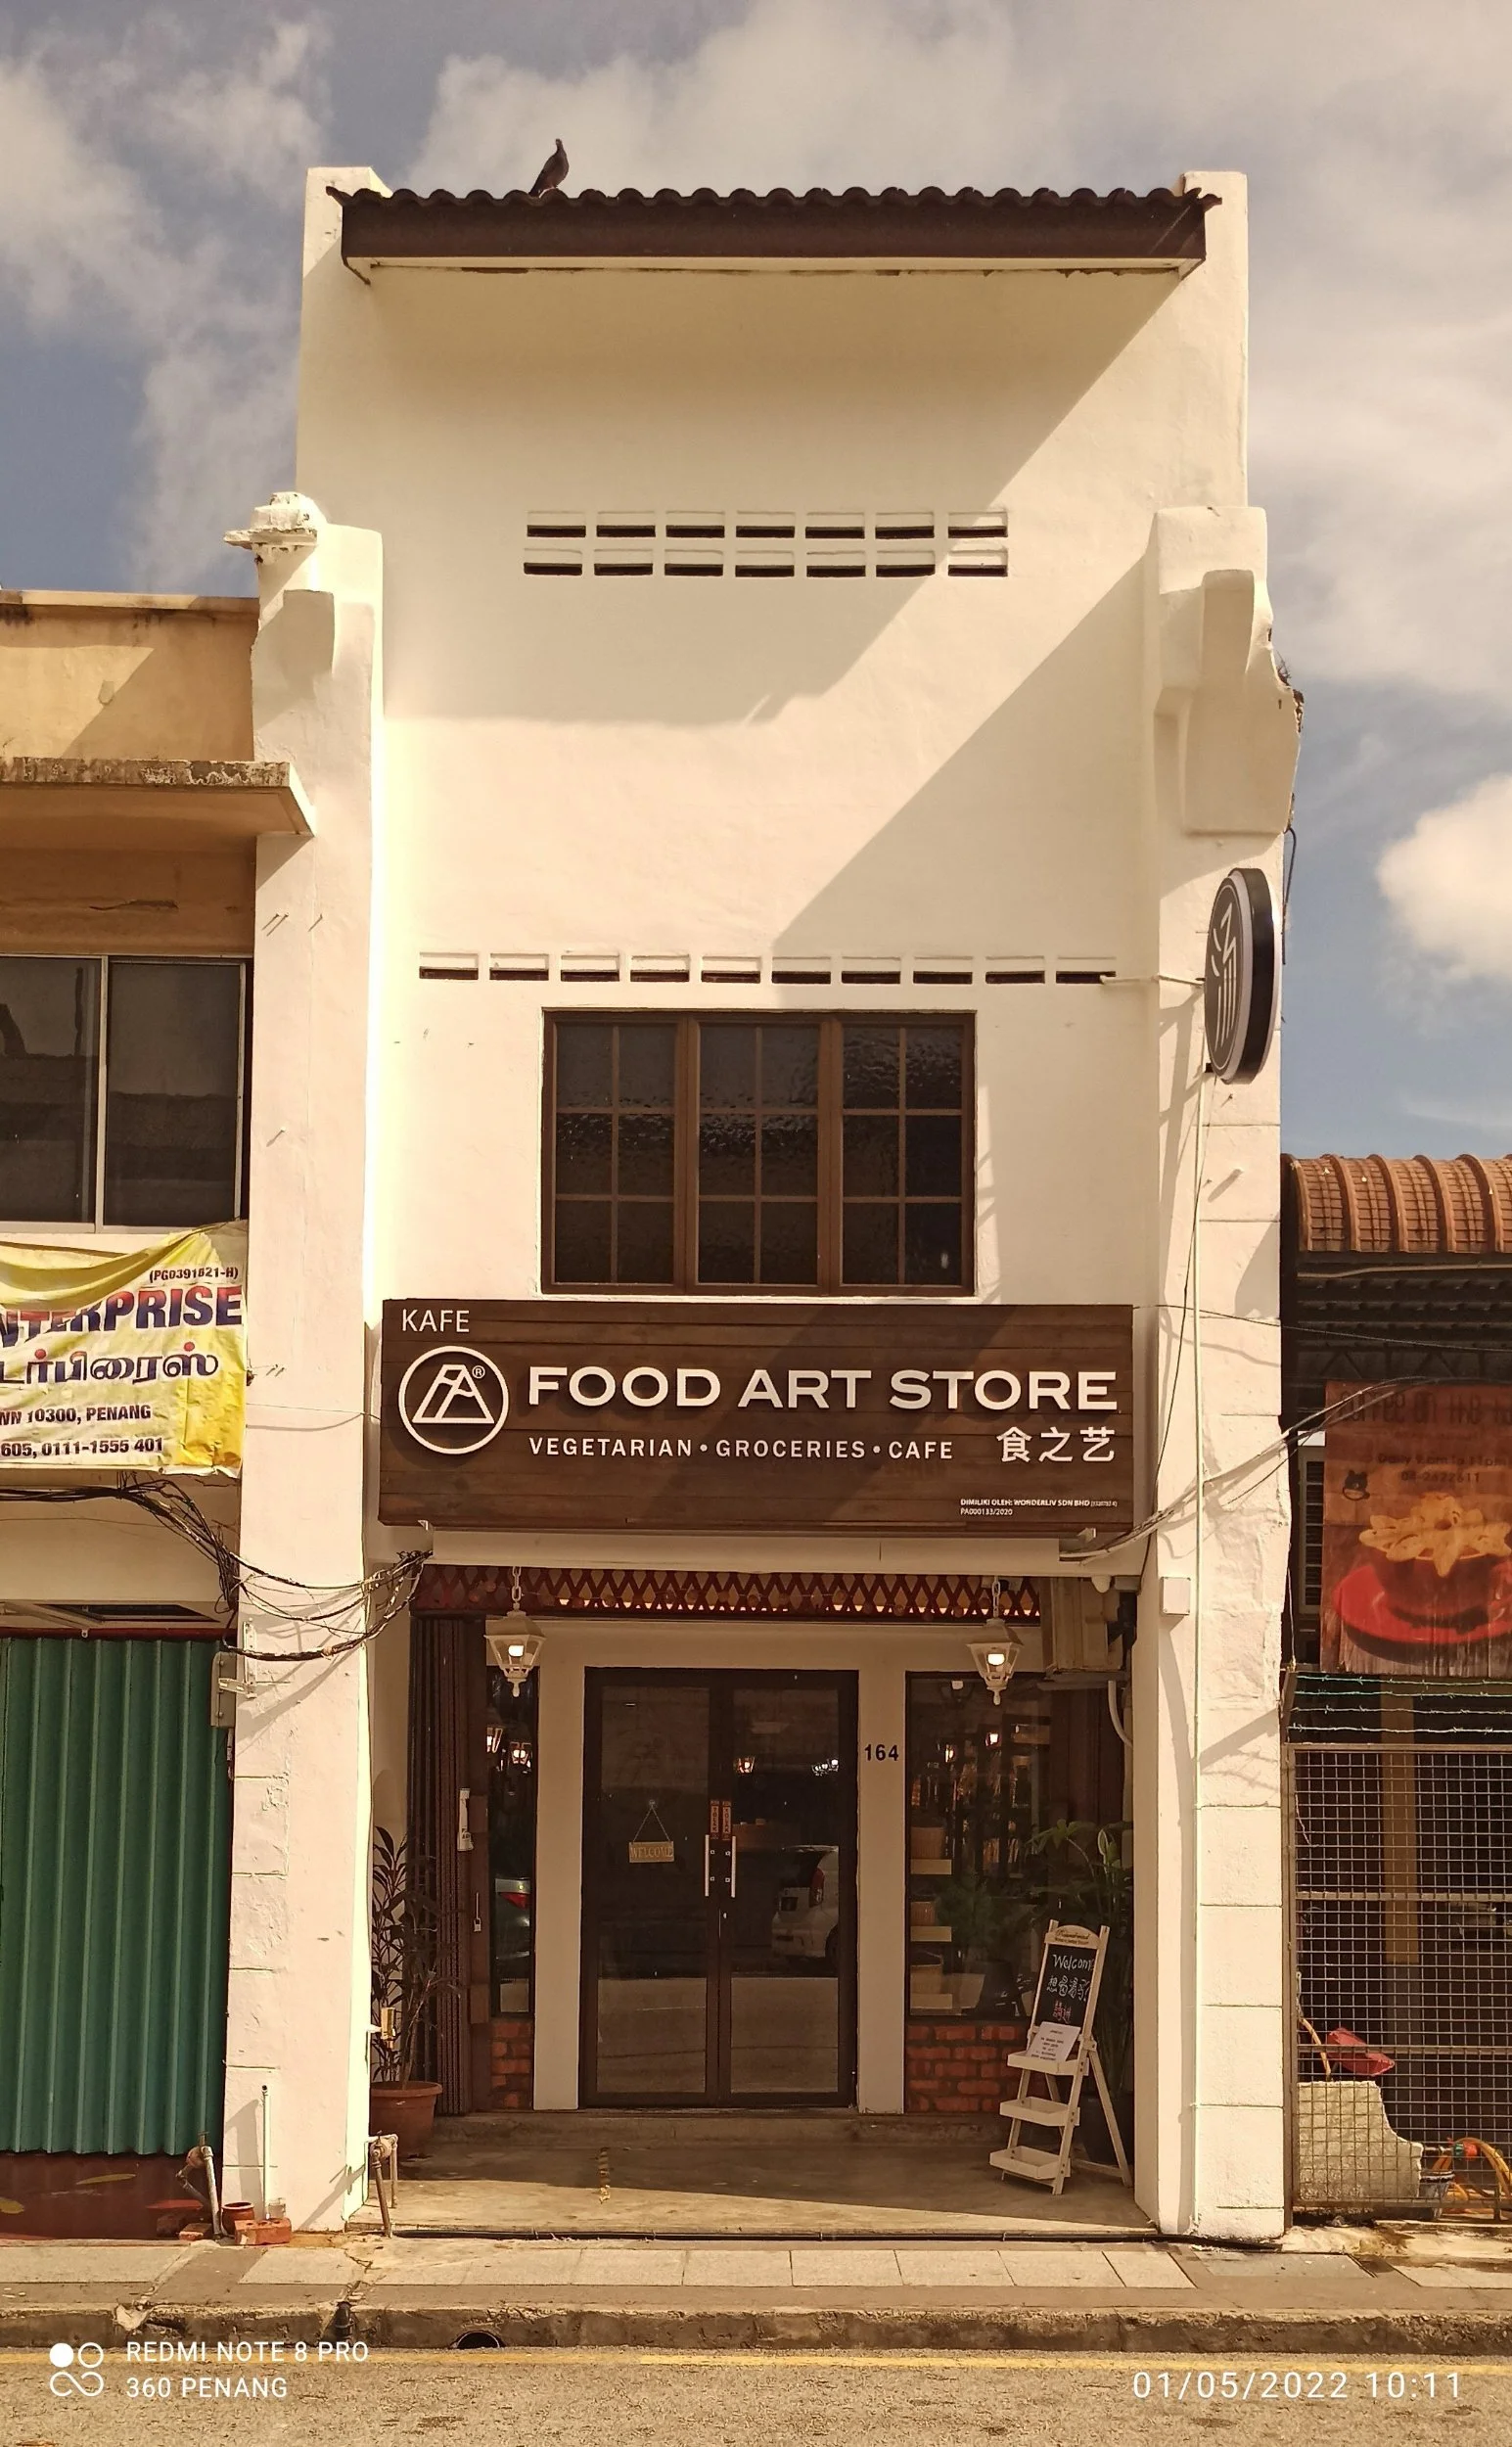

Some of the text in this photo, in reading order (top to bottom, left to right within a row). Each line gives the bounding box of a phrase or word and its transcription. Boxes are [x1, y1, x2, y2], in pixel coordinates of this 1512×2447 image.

[401, 1309, 471, 1333] KAFE
[528, 1365, 1118, 1410] FOOD ART STORE
[27, 1408, 81, 1425] 10300,
[86, 1405, 151, 1421] PENANG
[41, 1440, 129, 1456] 0111-1555
[134, 1437, 163, 1453] 401
[528, 1437, 952, 1459] VEGETARIAN GROCERIES CAFE
[996, 1426, 1116, 1463] 食之艺
[864, 1744, 898, 1761] 164
[630, 1846, 673, 1859] WELCOME
